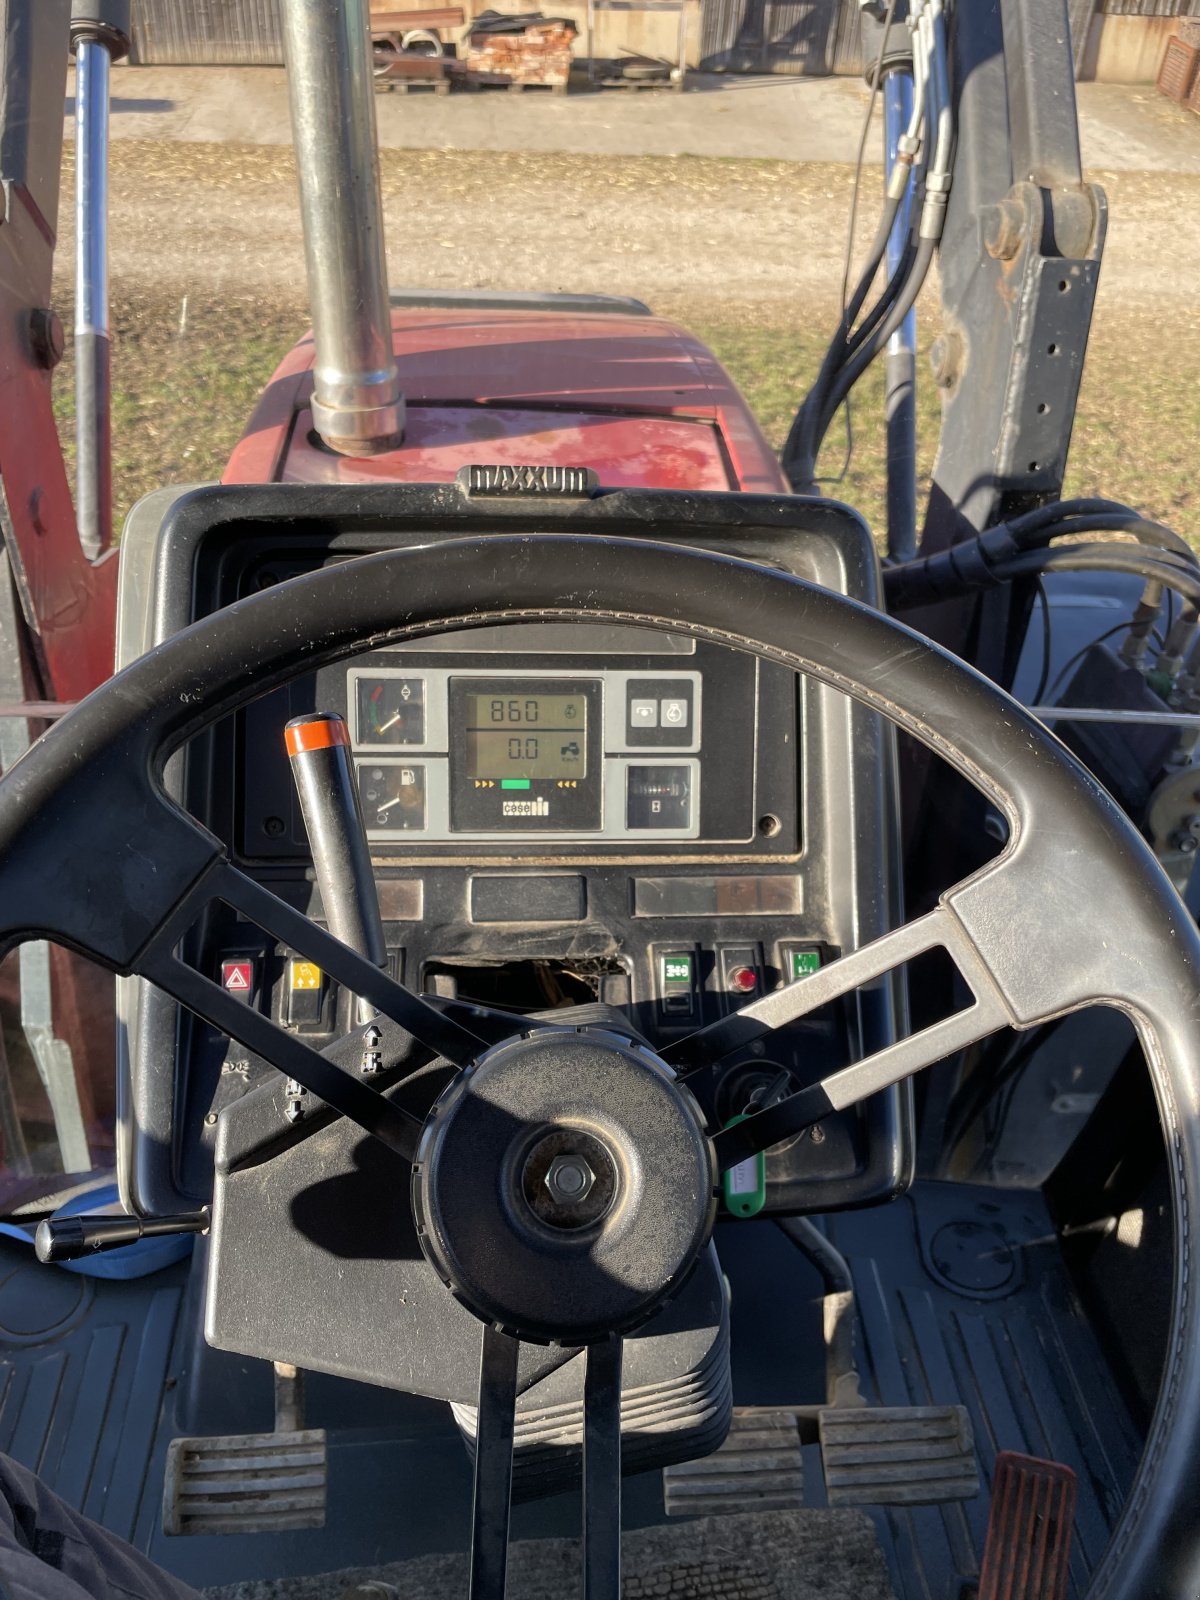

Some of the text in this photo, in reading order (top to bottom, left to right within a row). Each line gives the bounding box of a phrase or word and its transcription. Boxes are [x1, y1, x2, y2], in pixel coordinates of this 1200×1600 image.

[470, 465, 588, 491] MAXXUM
[491, 700, 538, 722] 860
[508, 738, 538, 759] 0.0
